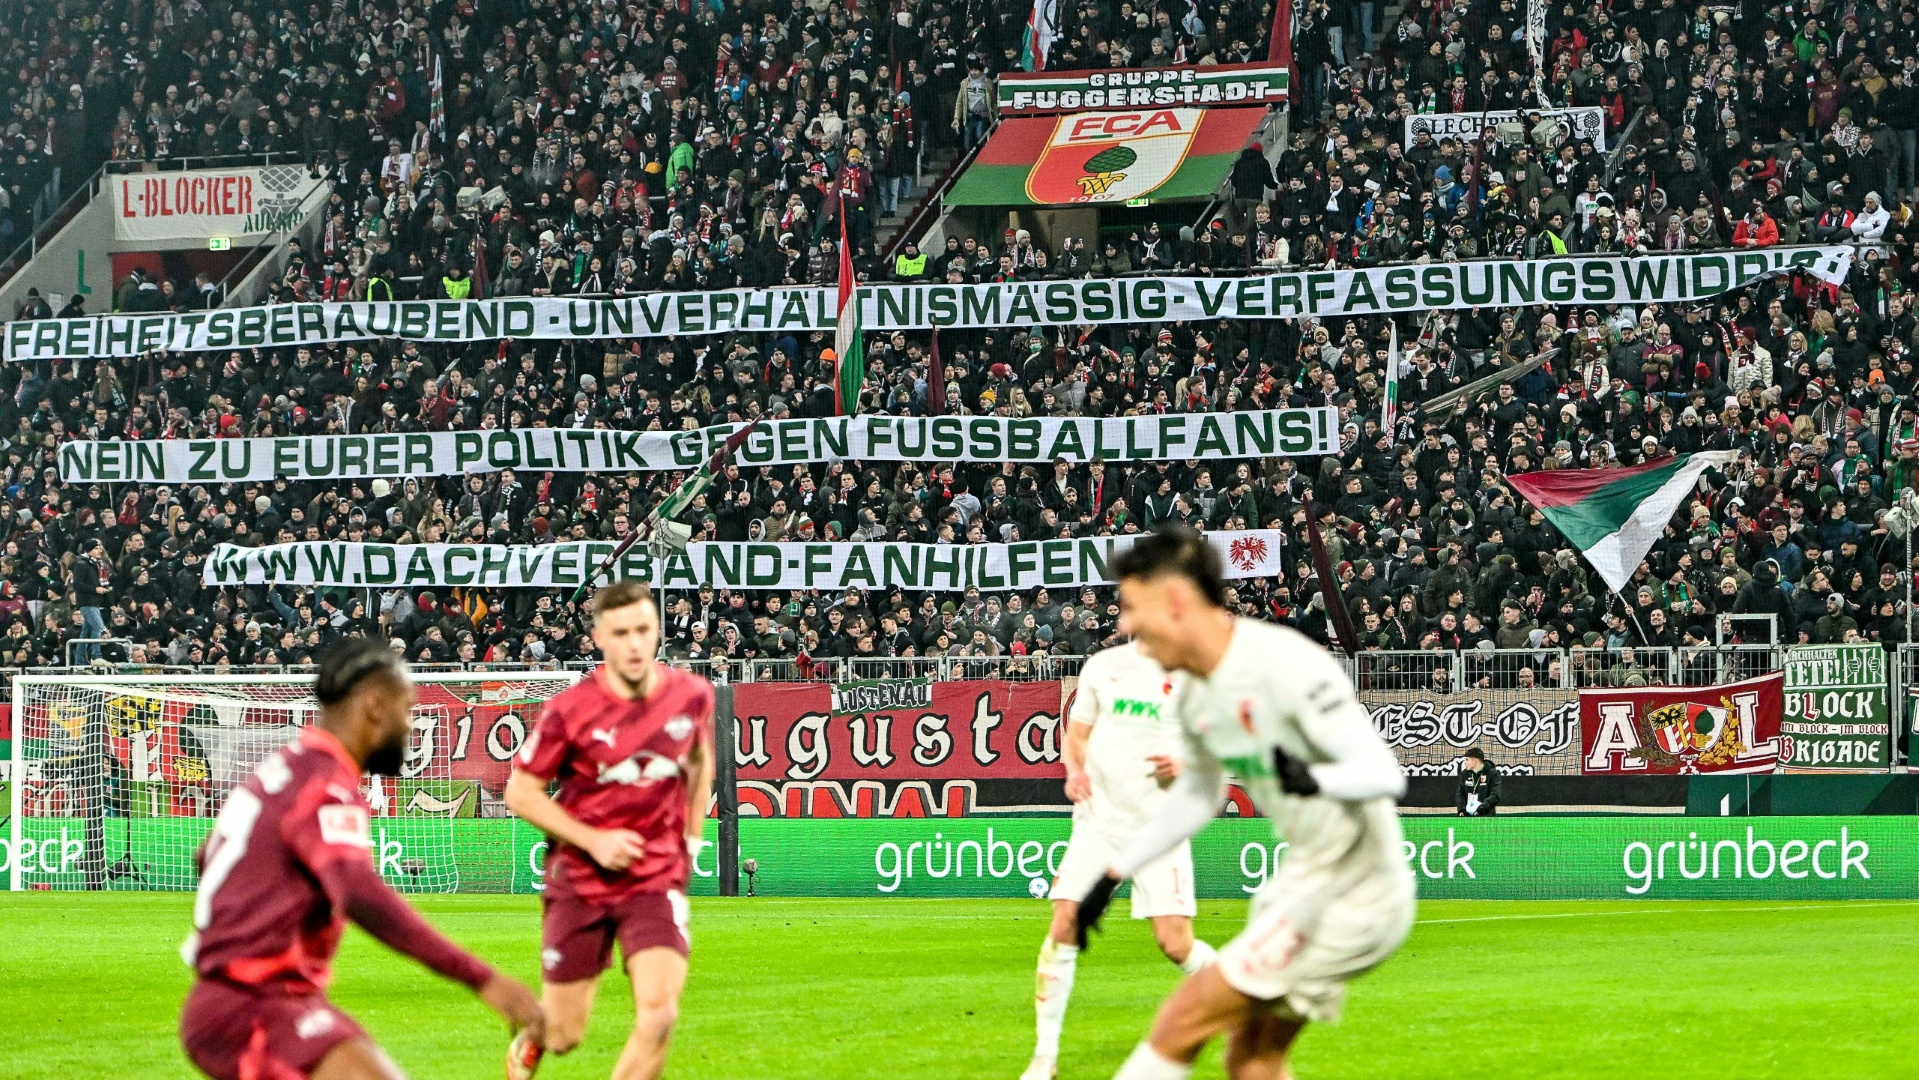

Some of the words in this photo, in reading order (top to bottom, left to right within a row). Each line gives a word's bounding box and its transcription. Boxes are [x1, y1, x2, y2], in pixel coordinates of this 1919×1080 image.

[1089, 70, 1196, 87] GRUPPE
[1012, 80, 1271, 110] FUGGERSTADT
[1070, 111, 1182, 136] FCA
[122, 176, 252, 218] L-BLOCKER
[61, 442, 165, 481] NEIN
[190, 440, 251, 479] ZU
[274, 434, 433, 477] EURER
[455, 430, 649, 470] POLITIK
[670, 416, 850, 466] GEGEN
[866, 408, 1328, 460] FUSSBALLFANS!
[212, 540, 1208, 586] WWW.DACHVERBAND-FANHILFEN
[837, 680, 928, 713] LUSTENAU
[1112, 698, 1163, 721] WWK
[1784, 691, 1874, 721] BLOCK
[400, 704, 528, 779] gio
[734, 690, 1061, 780] ugusta
[1859, 724, 1888, 734] BLOCK
[1778, 735, 1881, 765] BRIGADE
[875, 827, 1069, 893] grünbec
[1623, 827, 1870, 894] grünbeck
